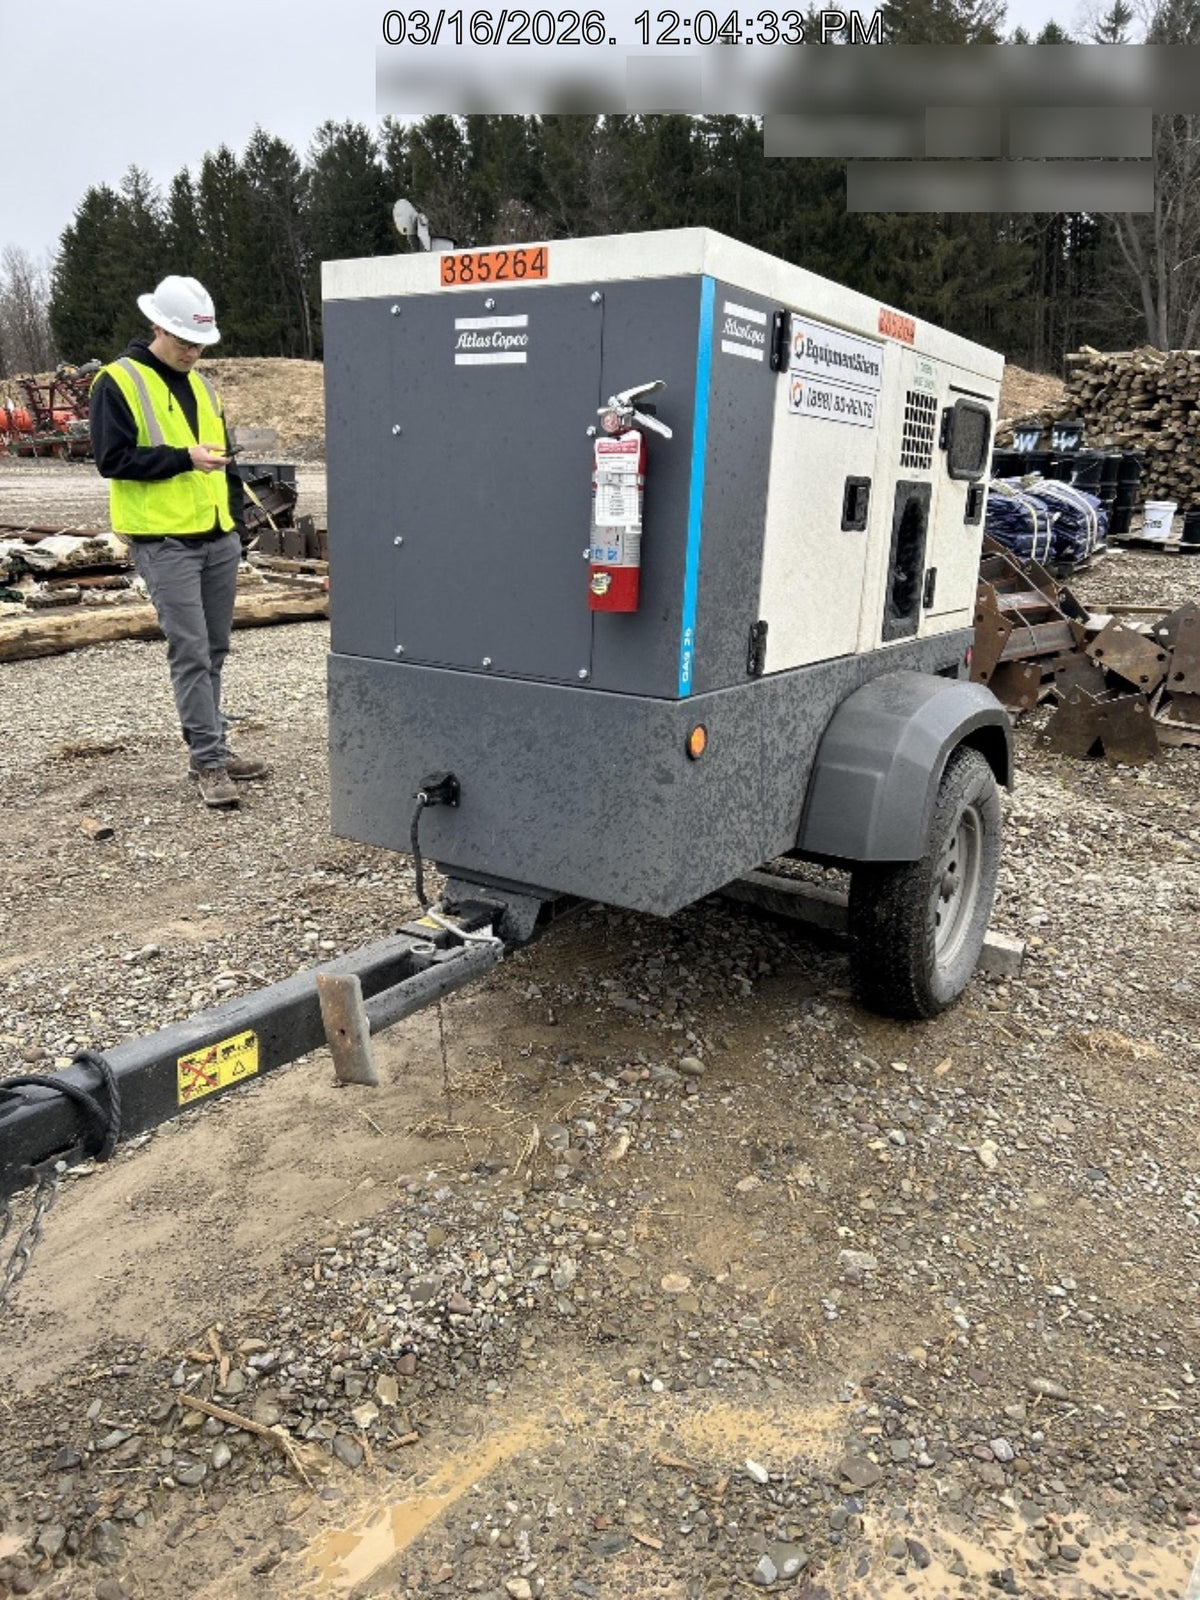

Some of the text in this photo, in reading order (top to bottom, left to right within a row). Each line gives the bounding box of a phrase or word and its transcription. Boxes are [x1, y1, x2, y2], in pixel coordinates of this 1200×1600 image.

[443, 247, 546, 284] 385264
[455, 331, 529, 350] Atlas Copco
[805, 338, 880, 376] EquipmentShare
